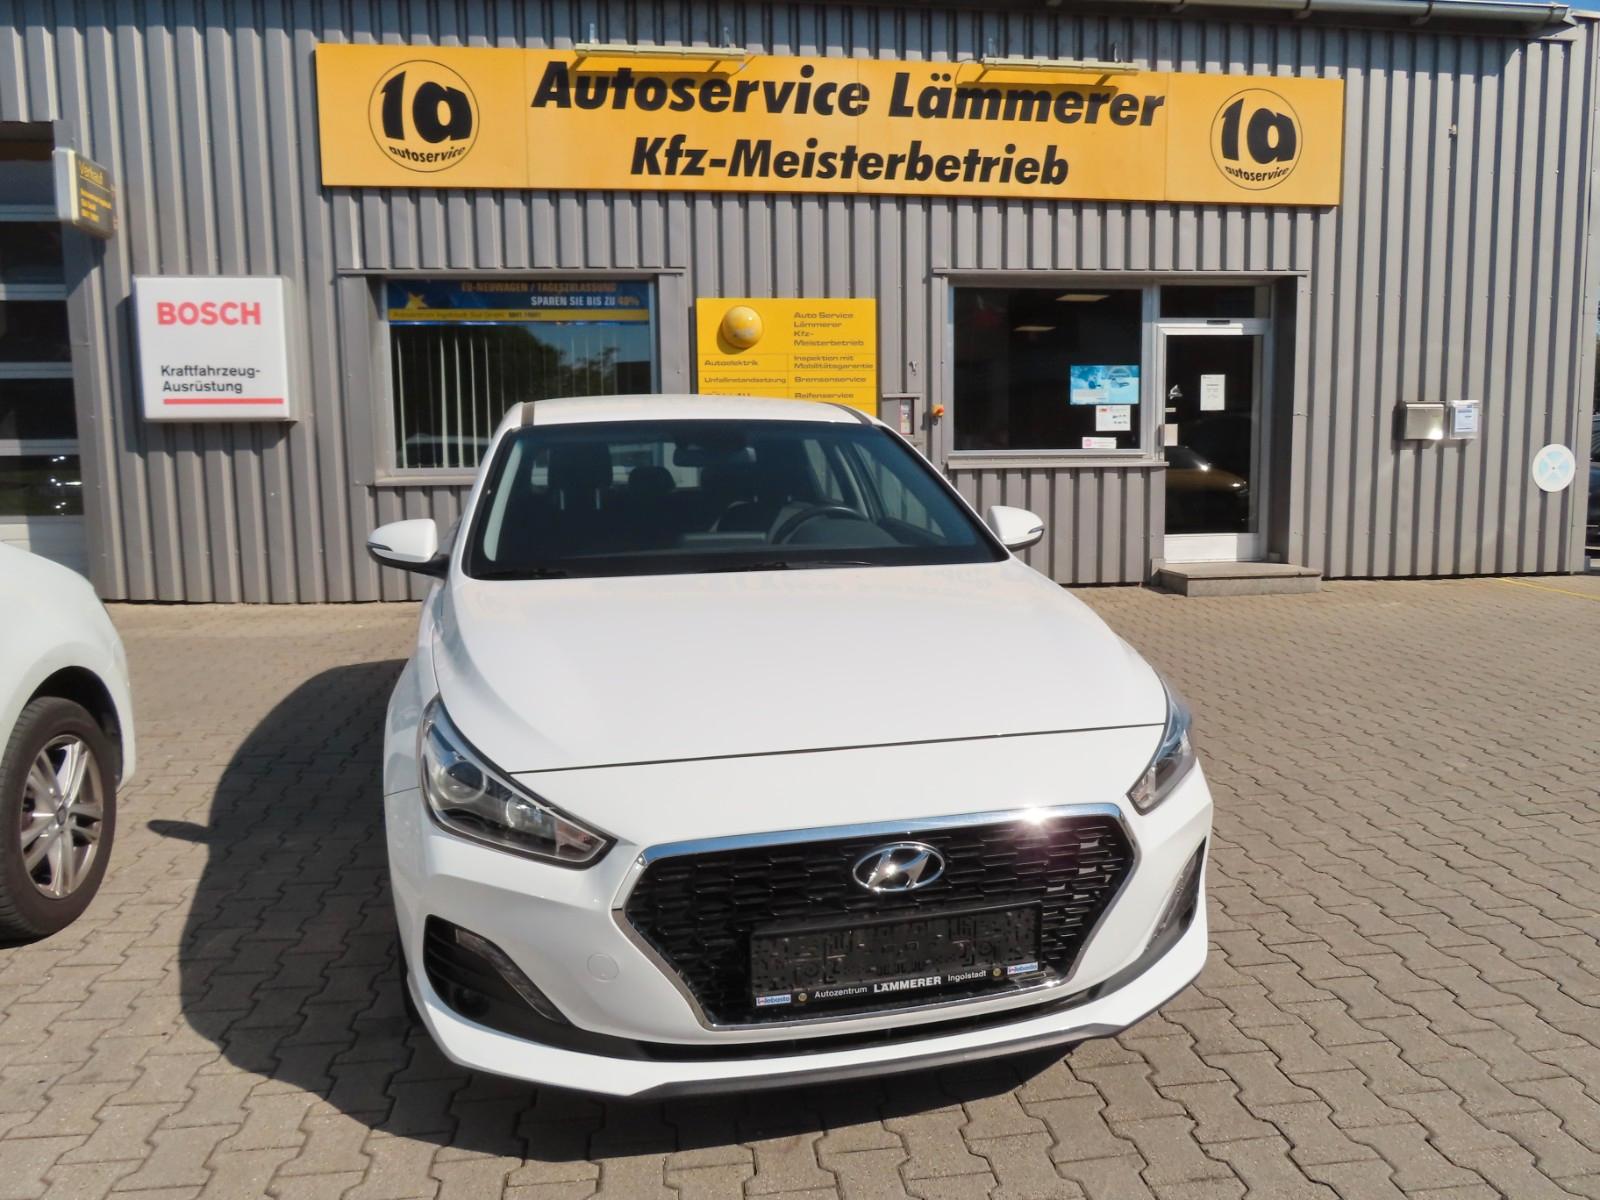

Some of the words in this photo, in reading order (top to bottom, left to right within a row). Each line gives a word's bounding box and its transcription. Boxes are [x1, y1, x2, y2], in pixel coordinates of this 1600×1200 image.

[531, 61, 870, 117] Autoservice
[889, 71, 1164, 126] Lämmerer
[381, 71, 472, 144] 1a
[1221, 97, 1297, 165] 1a
[388, 145, 466, 163] autoservice
[630, 134, 1069, 185] Kfz-Meisterbetrieb
[1224, 166, 1291, 183] autoservice
[530, 295, 567, 306] SPAREN
[569, 295, 583, 306] SIE
[587, 295, 602, 306] BIS
[605, 295, 616, 306] ZU
[156, 302, 262, 325] BOSCH
[793, 339, 865, 347] Meisterbetrieb
[160, 365, 261, 380] Kraftfahrzeug-
[162, 380, 243, 394] Ausrüstung
[814, 985, 868, 999] Autozentrum
[873, 976, 942, 993] LÄMMERER
[947, 969, 987, 982] Ingolstadt
